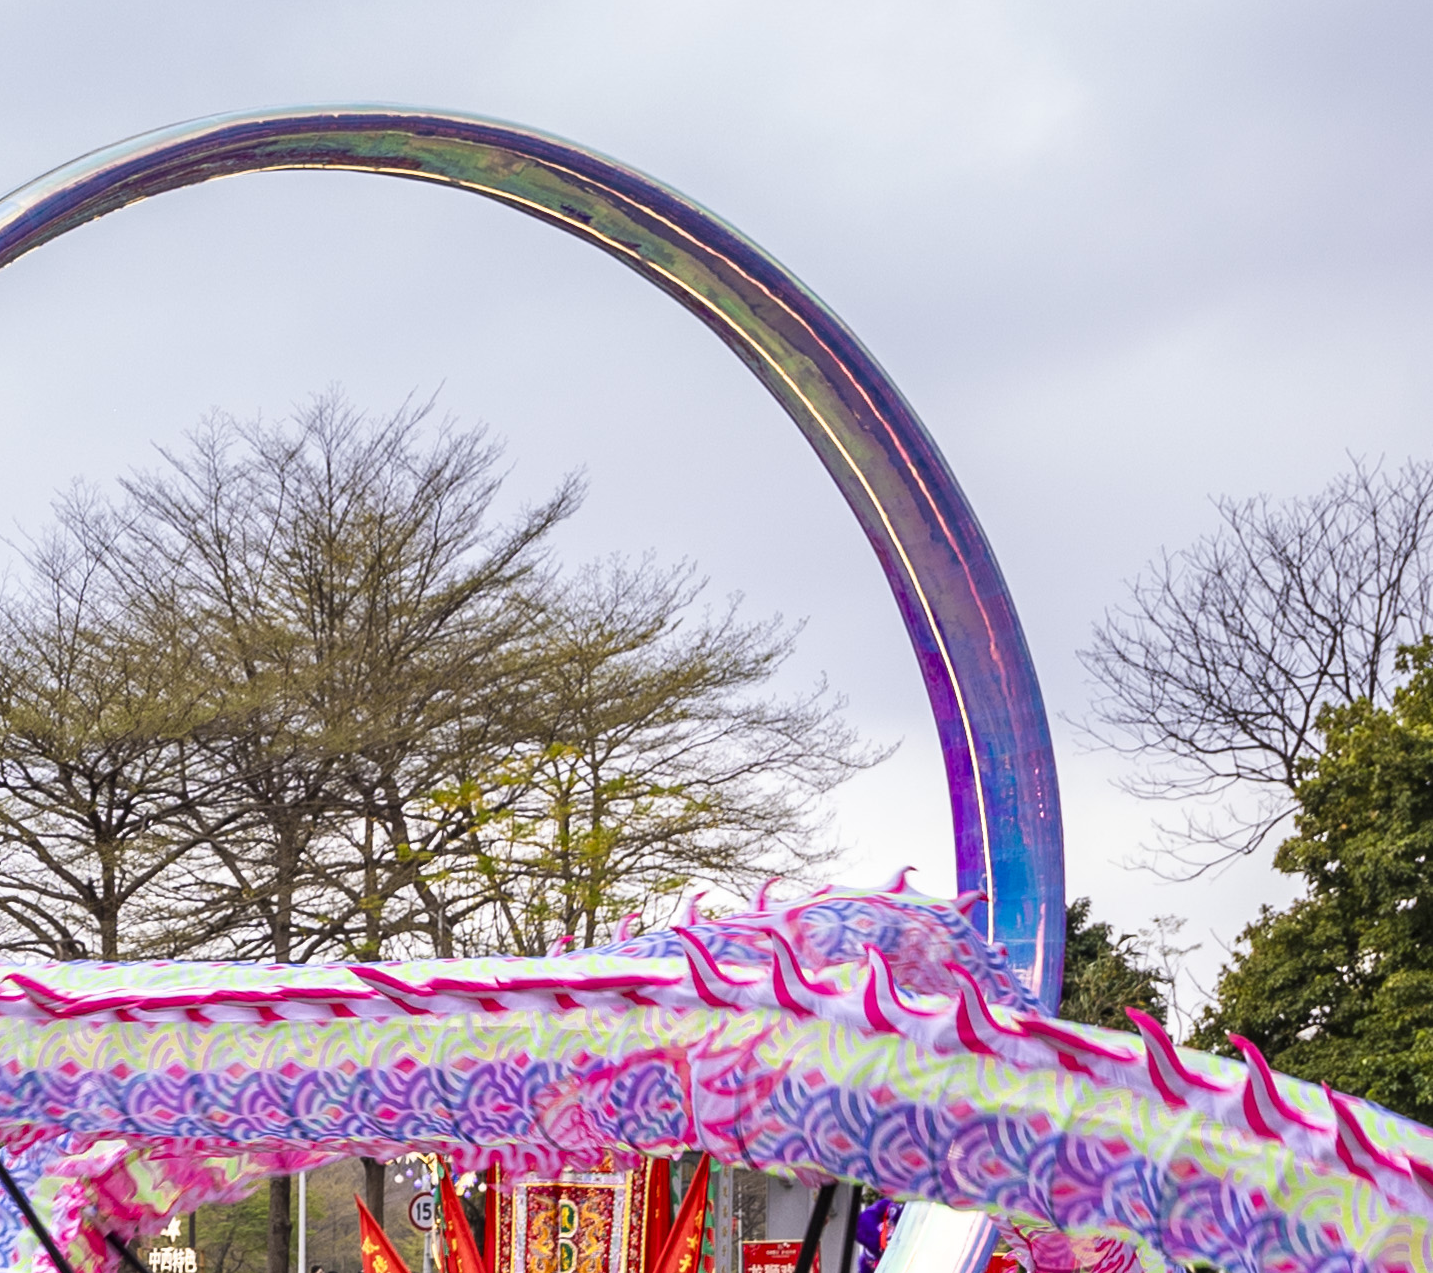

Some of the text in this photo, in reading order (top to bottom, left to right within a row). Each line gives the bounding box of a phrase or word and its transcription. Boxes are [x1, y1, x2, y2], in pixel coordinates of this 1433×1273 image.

[416, 1202, 432, 1220] 15
[148, 1247, 198, 1273] 中西特色
